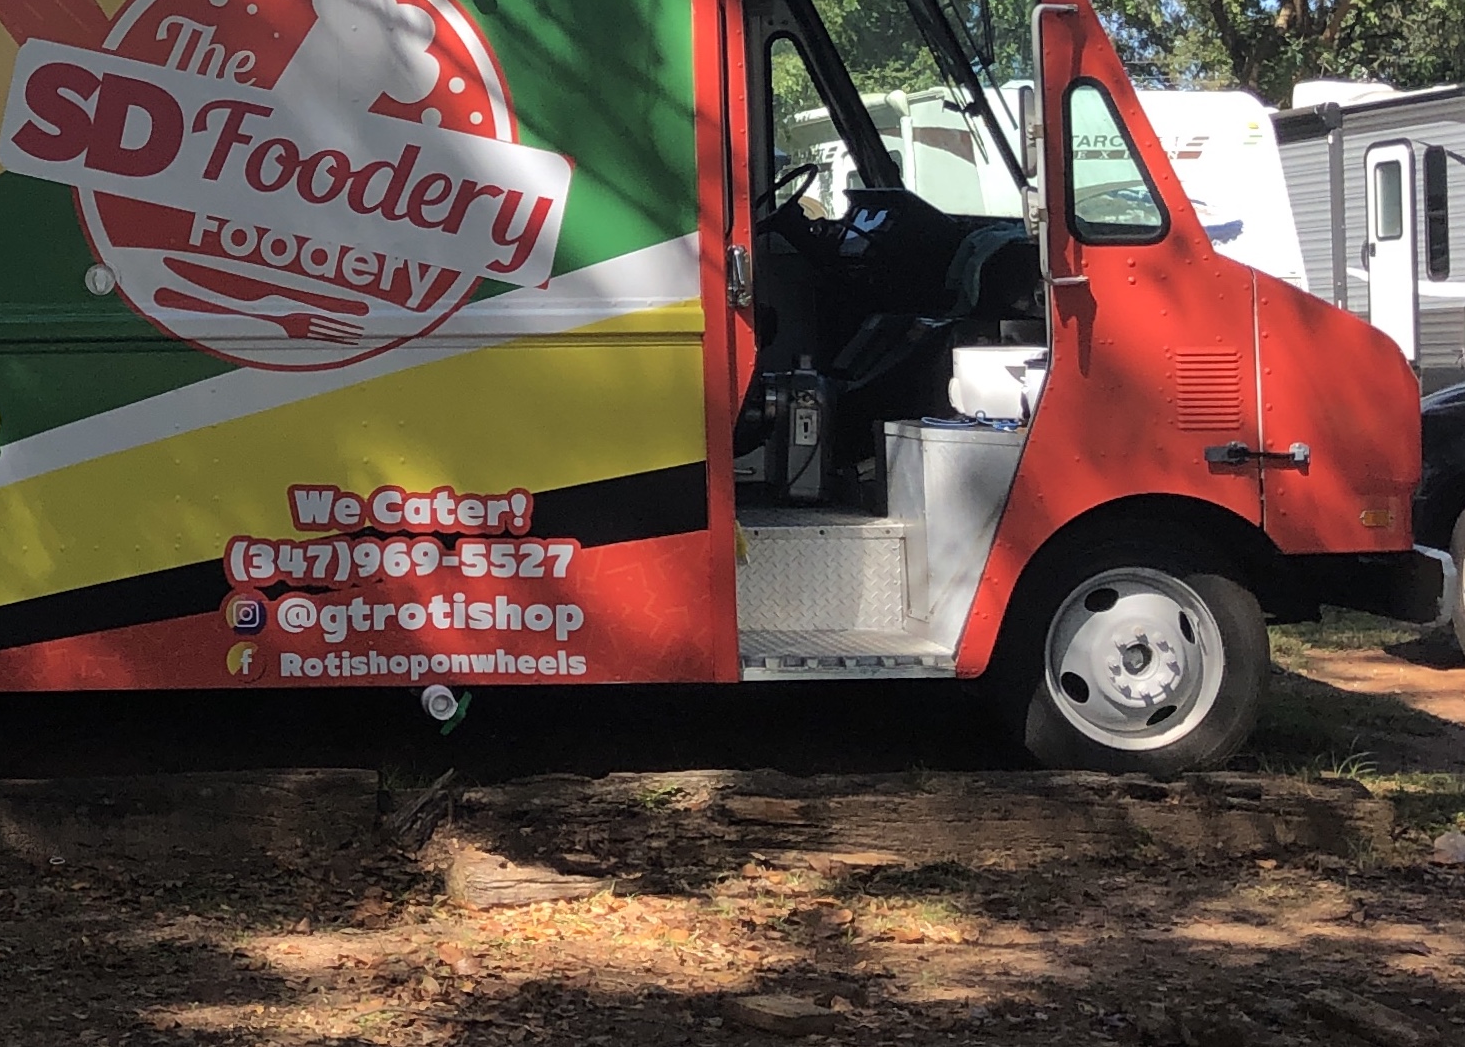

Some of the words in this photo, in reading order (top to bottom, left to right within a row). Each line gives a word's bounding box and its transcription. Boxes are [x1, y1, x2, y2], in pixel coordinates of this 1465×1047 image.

[156, 15, 258, 87] The
[11, 61, 185, 178] SD
[191, 98, 555, 274] Foodery
[294, 490, 362, 525] We
[372, 490, 527, 527] Cater!
[230, 540, 574, 581] (347)969-5527
[277, 592, 585, 643] @gtrotishop
[279, 649, 587, 681] Rotishoponwheels
